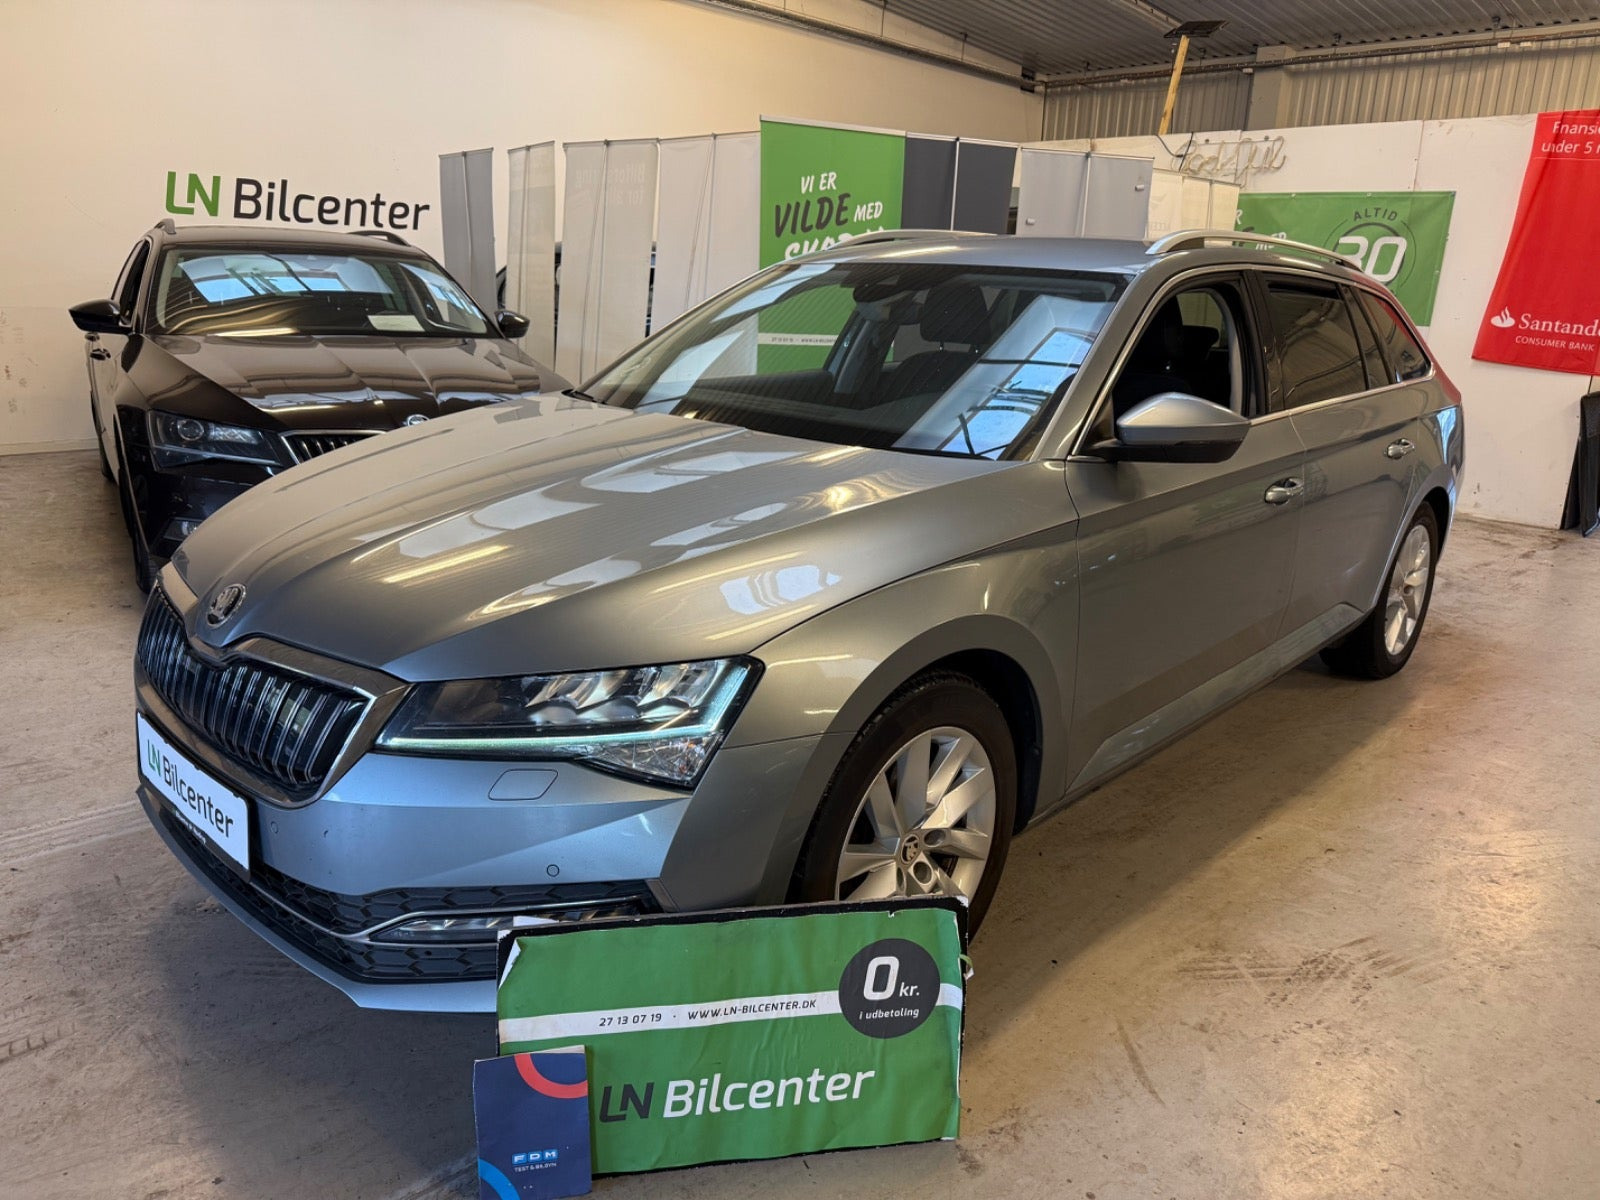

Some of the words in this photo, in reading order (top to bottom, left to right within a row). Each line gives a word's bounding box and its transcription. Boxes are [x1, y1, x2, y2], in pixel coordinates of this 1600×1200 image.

[1583, 141, 1594, 154] 5
[801, 175, 815, 195] VI
[819, 171, 837, 191] ER
[165, 170, 221, 217] LN
[233, 177, 430, 231] Bilcenter
[774, 192, 851, 238] VILDE
[854, 201, 883, 223] MED
[1353, 207, 1398, 222] ALTID
[1338, 235, 1407, 282] 30
[1518, 313, 1600, 336] Santand
[1515, 335, 1566, 349] CONSUMER
[1568, 341, 1595, 352] BANK
[147, 739, 161, 777] LN
[163, 755, 234, 838] Bilcenter
[863, 956, 900, 1001] 0
[899, 982, 920, 997] kr.
[599, 1017, 613, 1027] 27
[617, 1015, 628, 1026] 13
[632, 1014, 646, 1025] 07
[651, 1013, 662, 1023] 19
[688, 999, 817, 1020] WWW.LN-BILCENTER.DK
[859, 1011, 863, 1020] i
[866, 1007, 920, 1019] udbetaling
[599, 1082, 654, 1123] LN
[663, 1068, 876, 1118] Bilcenter
[513, 1150, 557, 1164] FDM
[514, 1165, 529, 1173] TEST
